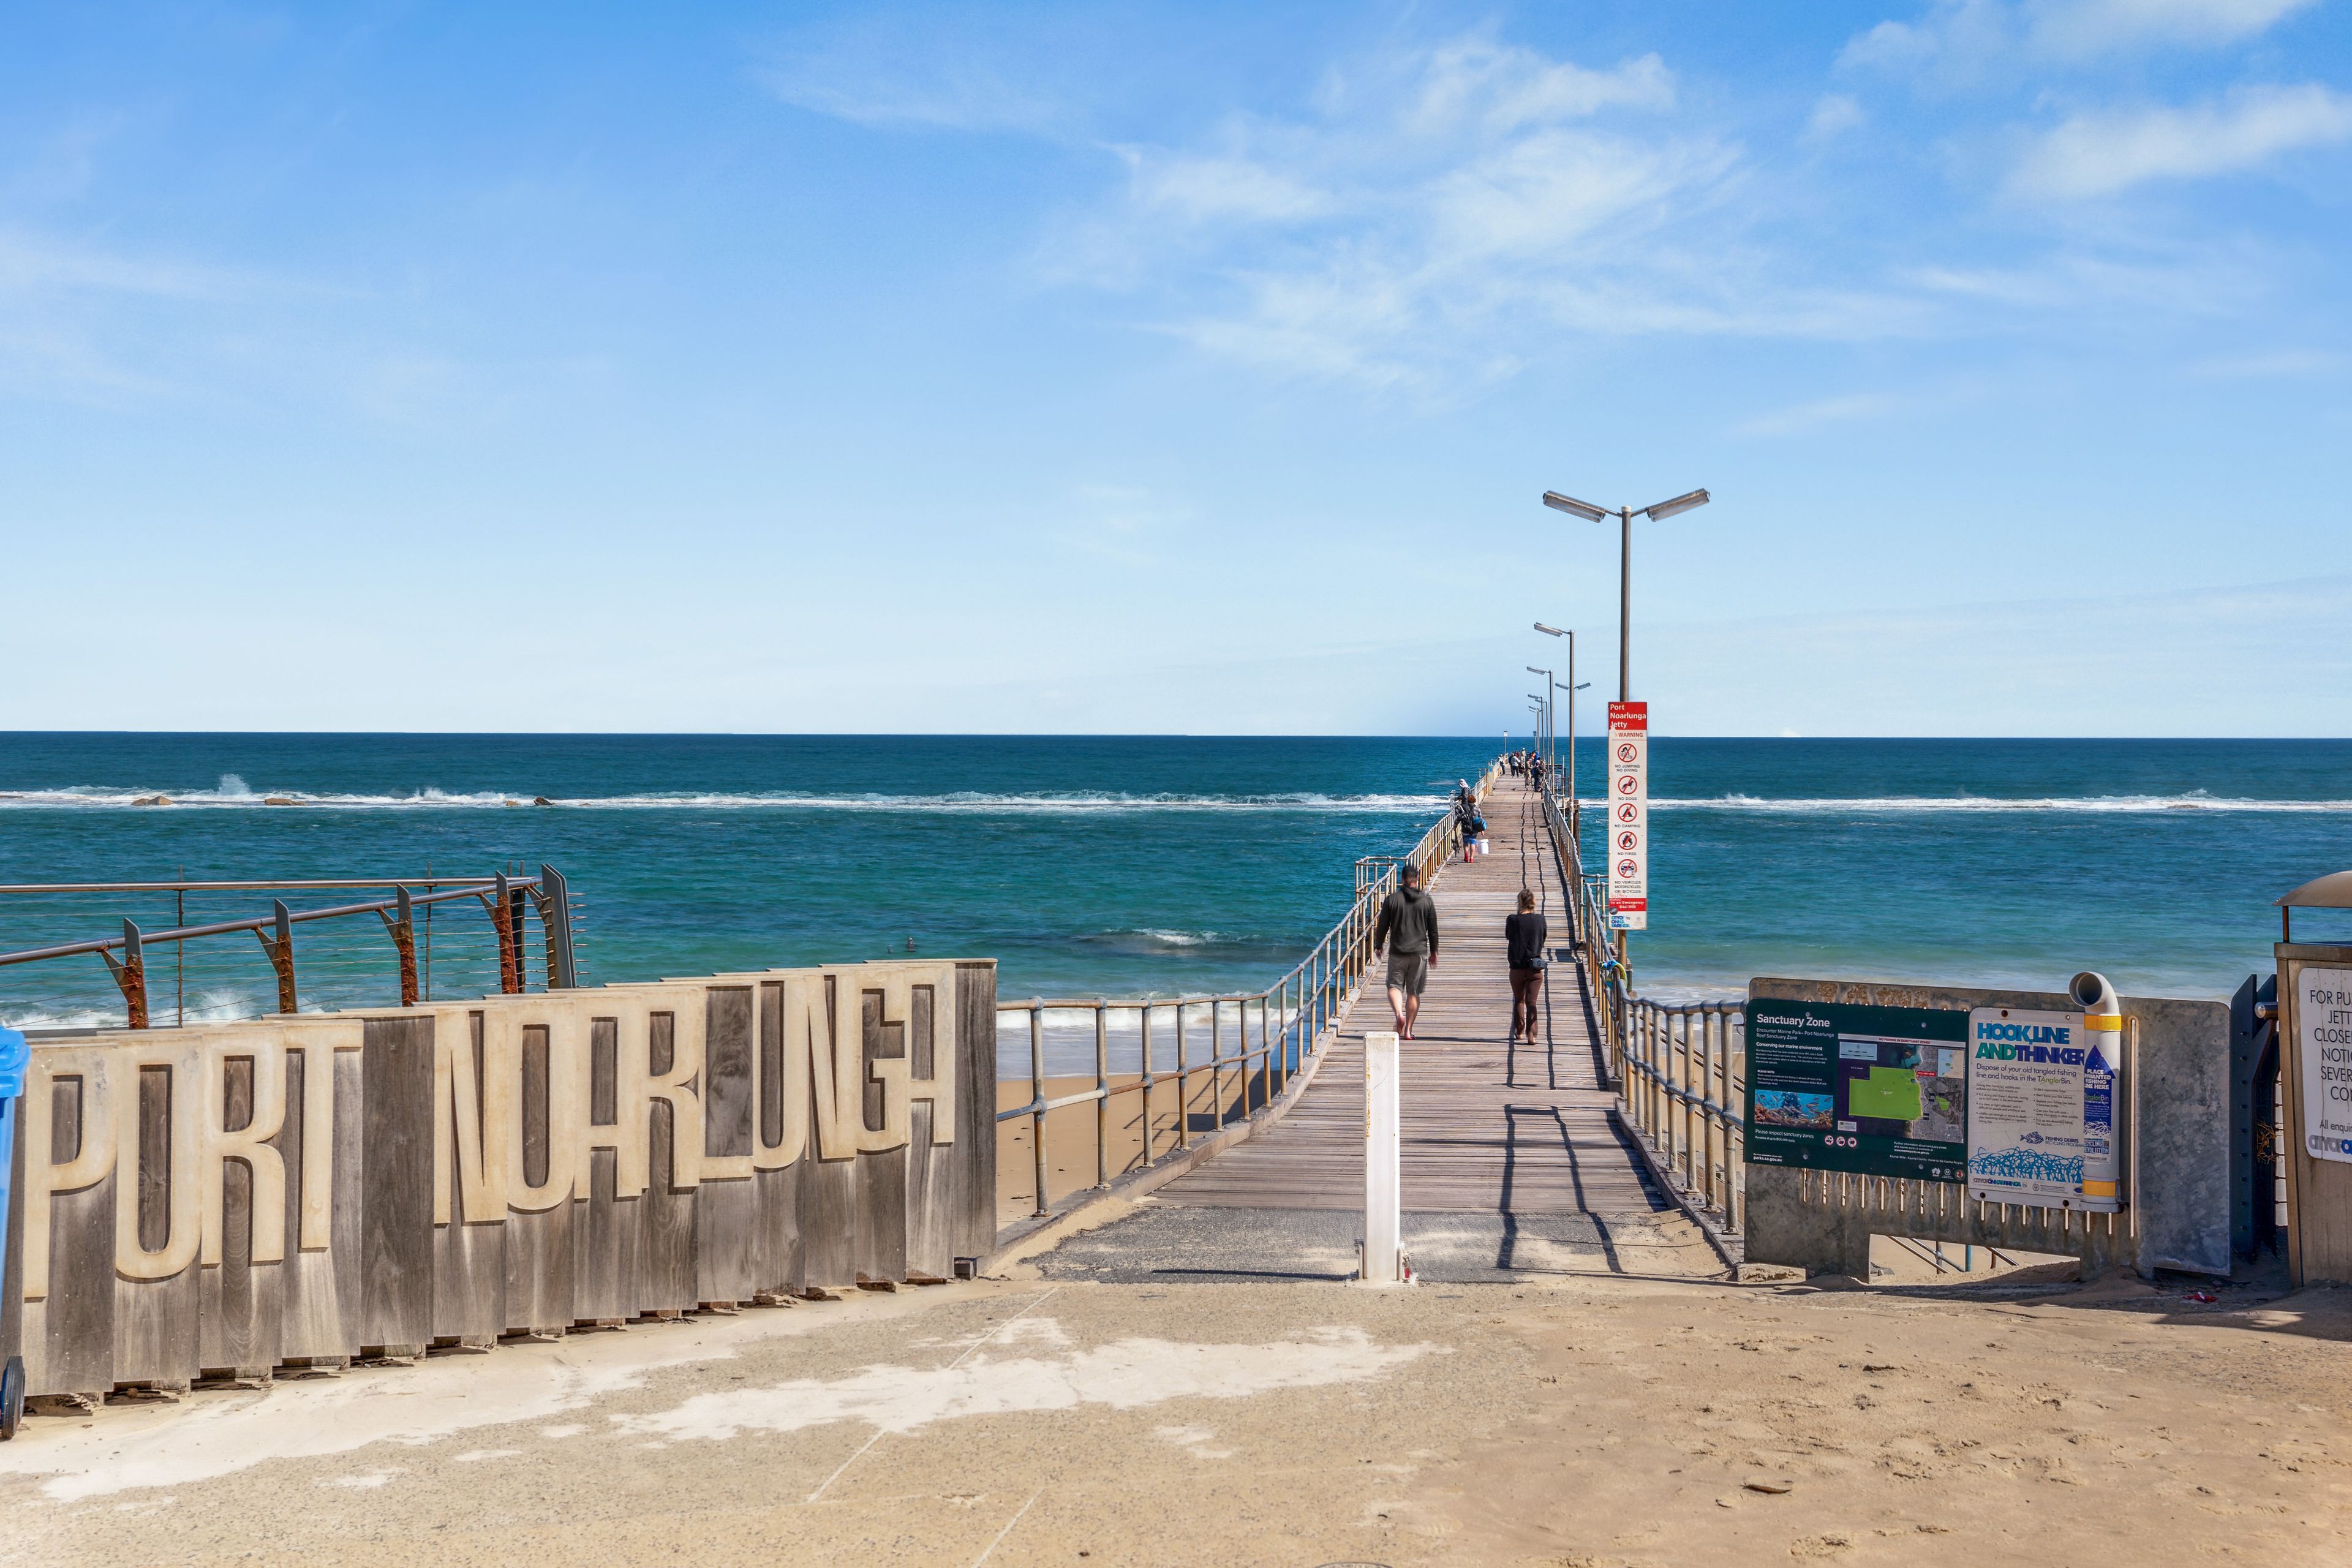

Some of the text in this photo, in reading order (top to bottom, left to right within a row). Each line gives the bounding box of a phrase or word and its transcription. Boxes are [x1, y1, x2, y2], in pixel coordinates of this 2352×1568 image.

[2310, 990, 2333, 1005] FOR
[1757, 1014, 1830, 1027] Sanctuary Zone
[2328, 1010, 2352, 1025] JETT
[2314, 1028, 2352, 1044] CLOSE
[2322, 1048, 2352, 1063] NOTI
[2057, 1069, 2076, 1077] fishing
[2331, 1087, 2352, 1101] CO
[24, 962, 956, 1298] PORT NOARLUNGA
[2320, 1120, 2329, 1129] All
